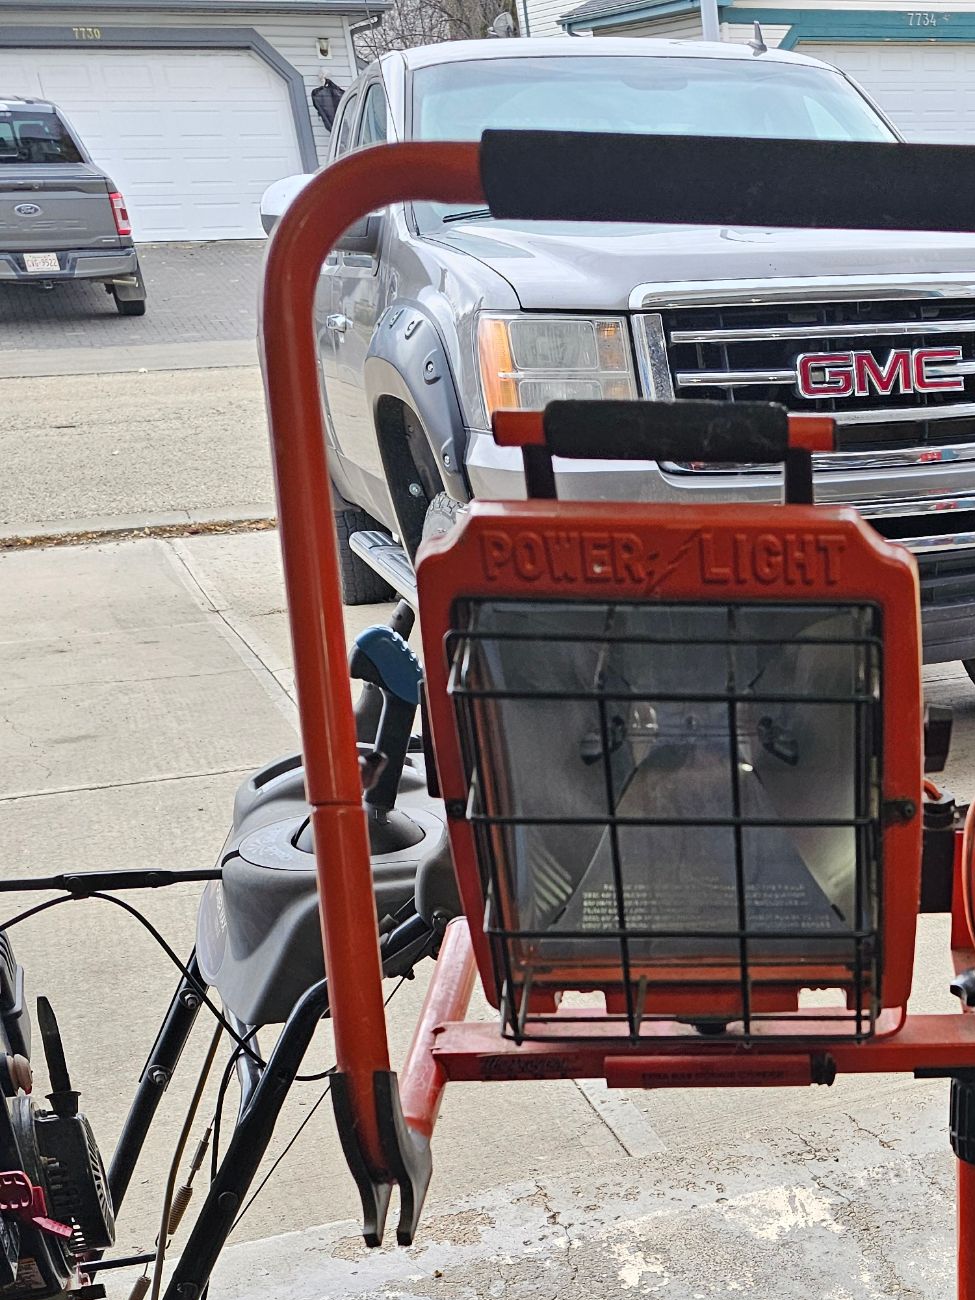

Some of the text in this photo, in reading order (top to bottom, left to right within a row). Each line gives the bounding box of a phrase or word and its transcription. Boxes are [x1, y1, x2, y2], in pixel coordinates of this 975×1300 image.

[72, 26, 101, 40] 7730
[907, 12, 937, 27] 7734
[797, 346, 965, 399] GMC
[479, 529, 848, 586] POWER LIGHT
